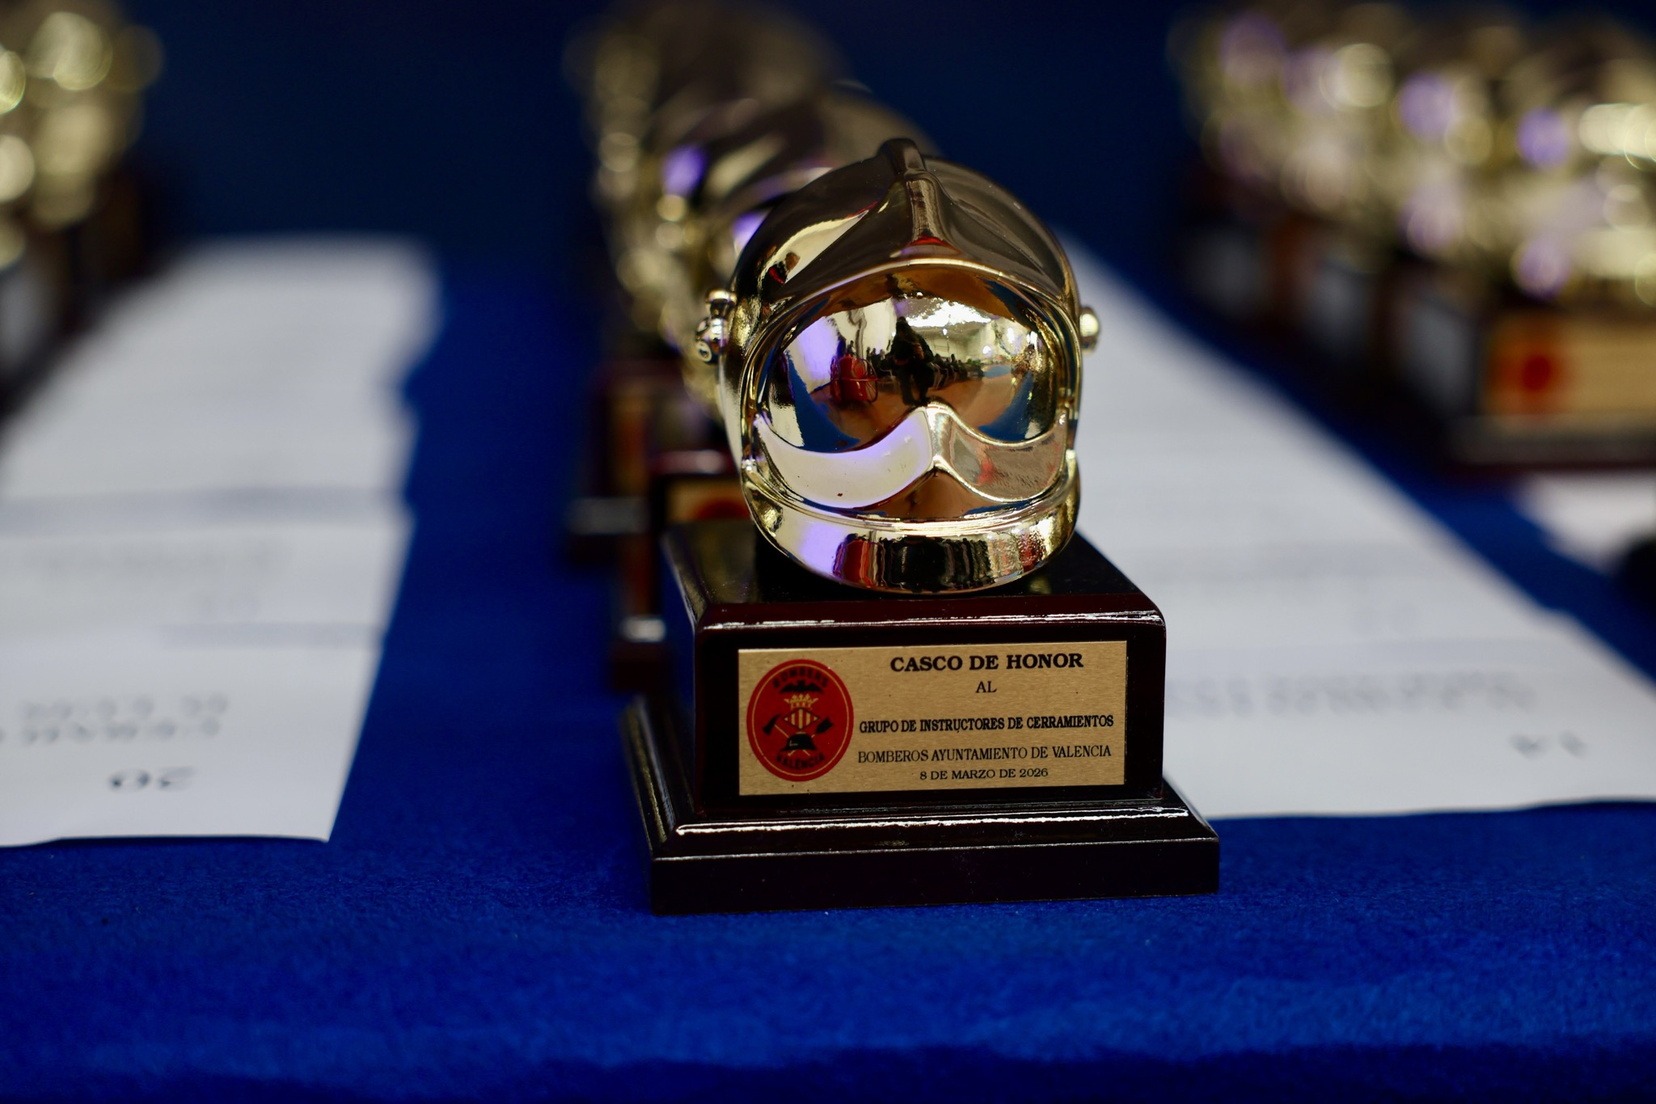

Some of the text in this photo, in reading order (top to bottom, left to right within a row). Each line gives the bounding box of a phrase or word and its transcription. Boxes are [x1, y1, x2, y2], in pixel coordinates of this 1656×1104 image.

[889, 652, 1085, 673] CASCO DE HONOR
[976, 680, 998, 694] AL
[859, 714, 1114, 734] GRUPO DE INSTRUCTORES DE CERRAMIENTOS
[858, 745, 1112, 763] BOMBEROS AYUNTAMIENTO DE VALENCIA
[920, 767, 1049, 781] 8 DE MARZO DE 2026
